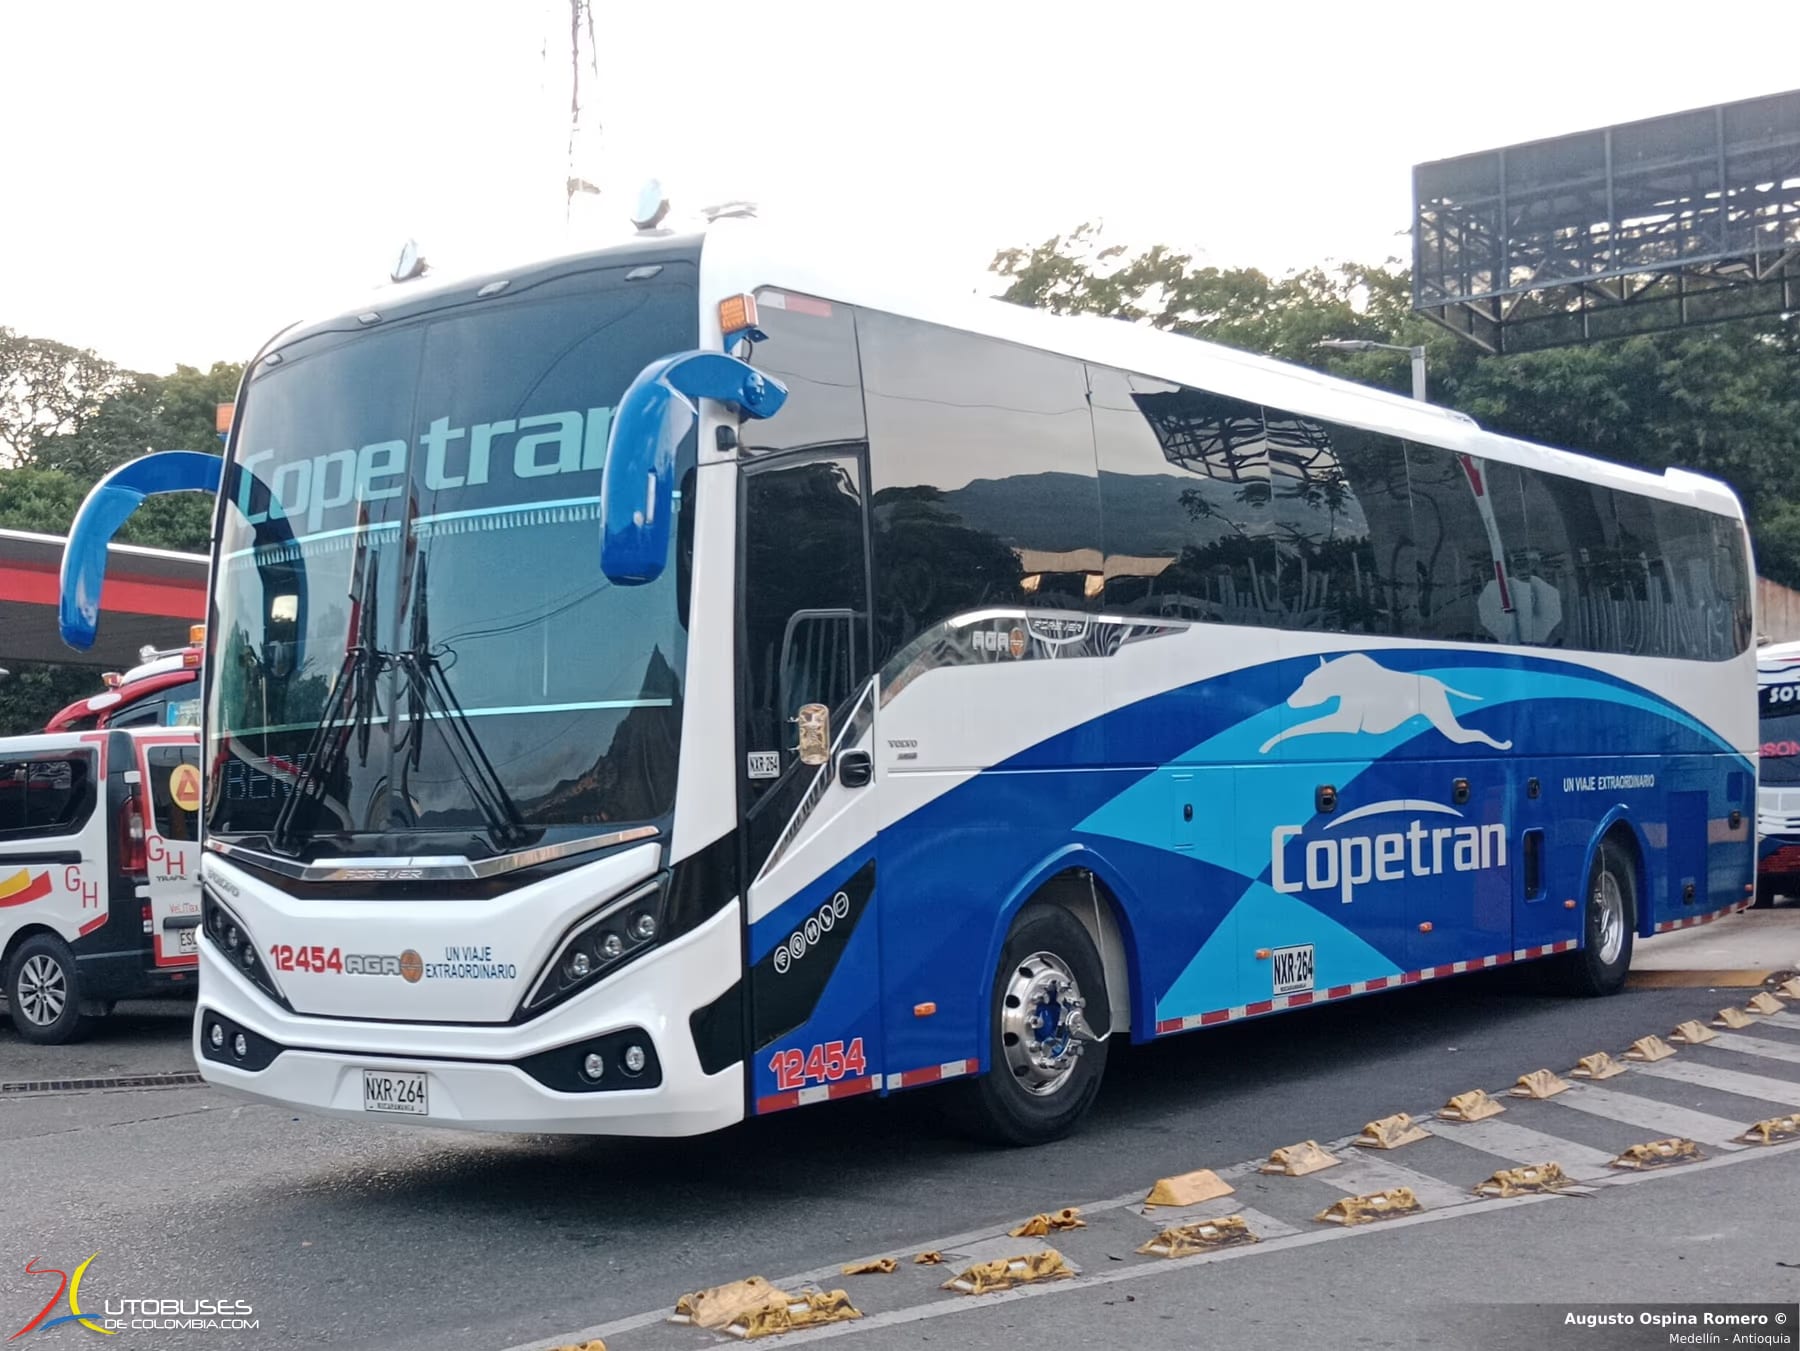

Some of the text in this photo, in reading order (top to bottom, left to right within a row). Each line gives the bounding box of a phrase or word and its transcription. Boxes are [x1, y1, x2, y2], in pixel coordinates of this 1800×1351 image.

[1563, 778, 1574, 792] UN
[1575, 776, 1596, 791] VIAJE
[1271, 820, 1506, 903] Copetran
[343, 869, 423, 879] FOREVER
[270, 944, 343, 974] 12454
[445, 947, 492, 961] UN VIAJE
[345, 954, 401, 975] AGA
[425, 963, 517, 979] EXTRAORDINARIO
[768, 1037, 866, 1091] 12454
